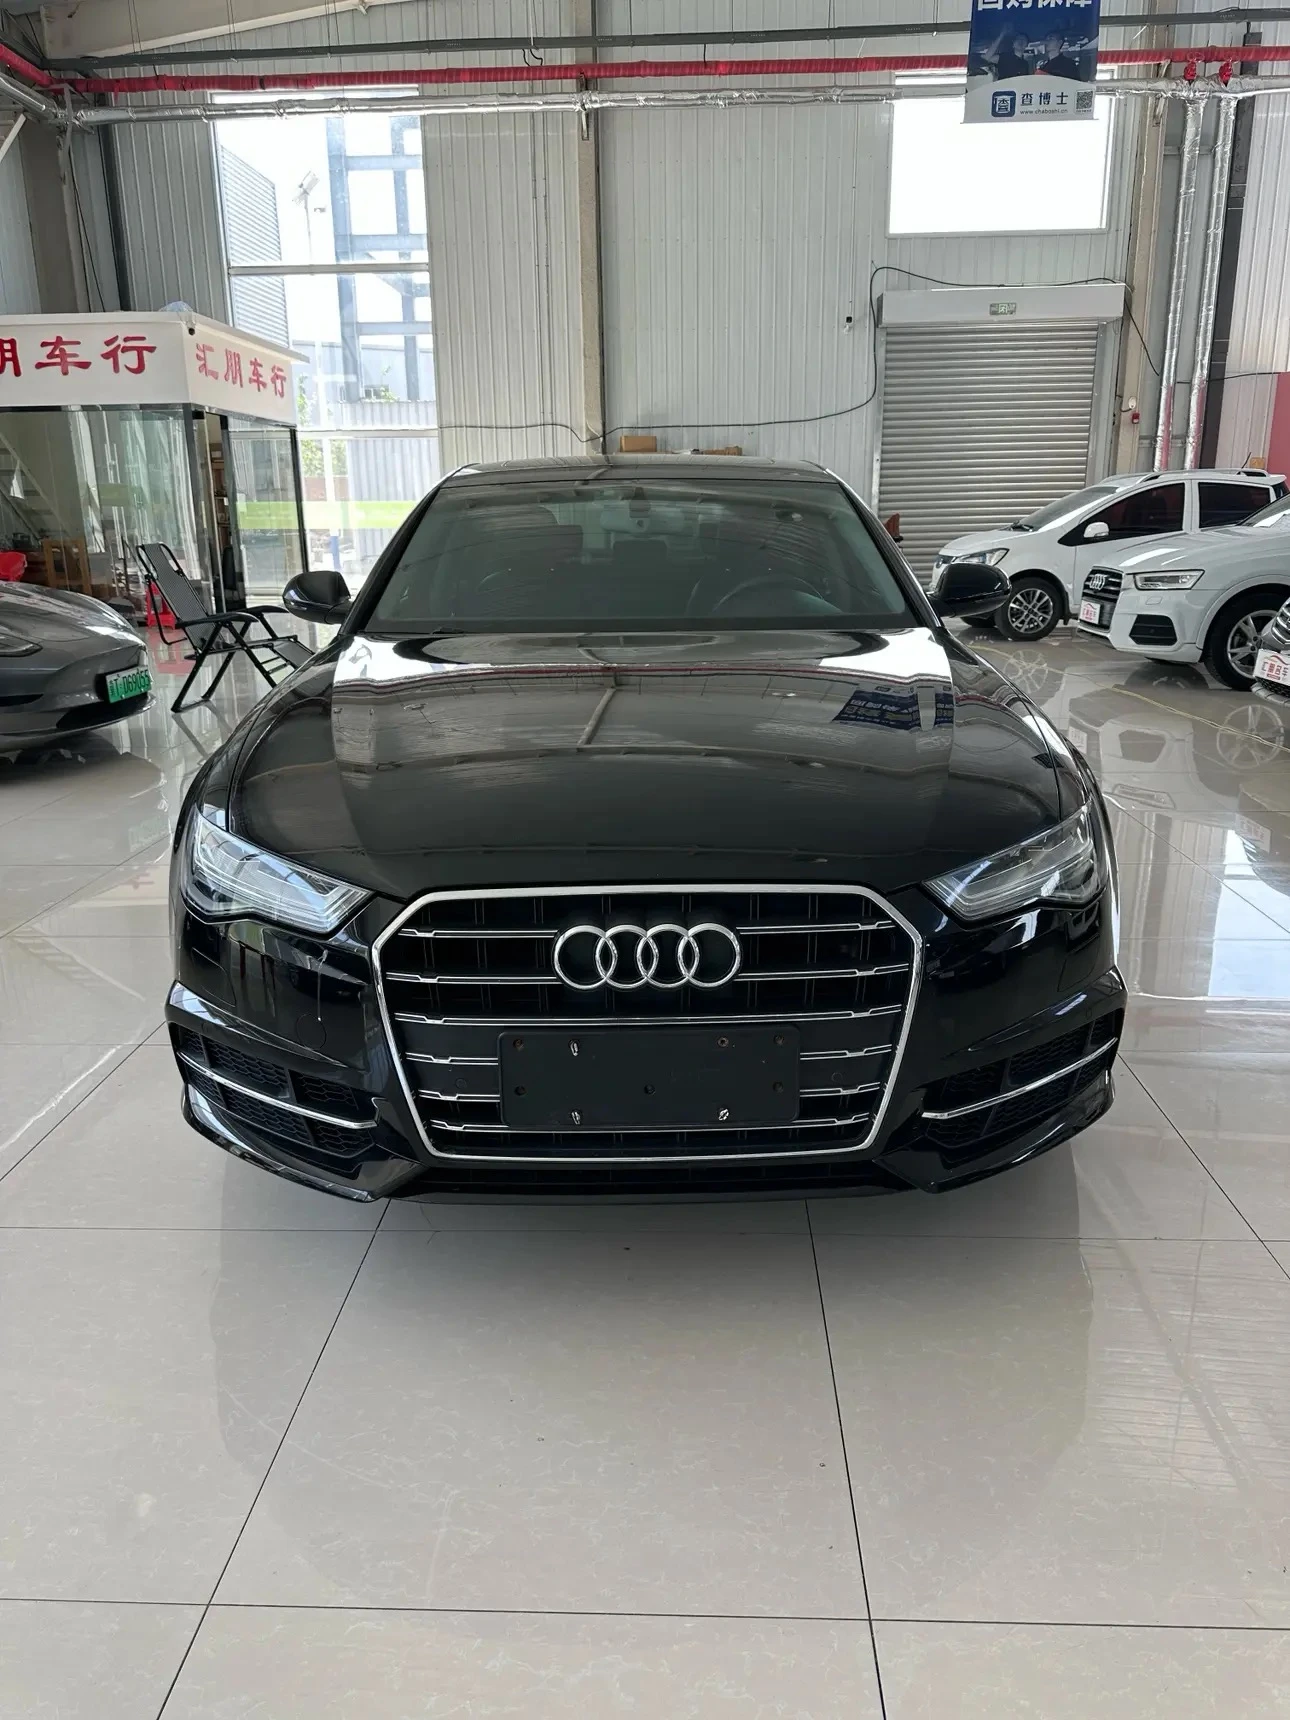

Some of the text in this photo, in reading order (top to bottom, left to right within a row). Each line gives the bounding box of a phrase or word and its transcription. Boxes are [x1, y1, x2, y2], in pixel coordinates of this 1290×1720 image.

[1020, 92, 1069, 106] 查博士
[195, 343, 287, 398] 汇朋车行
